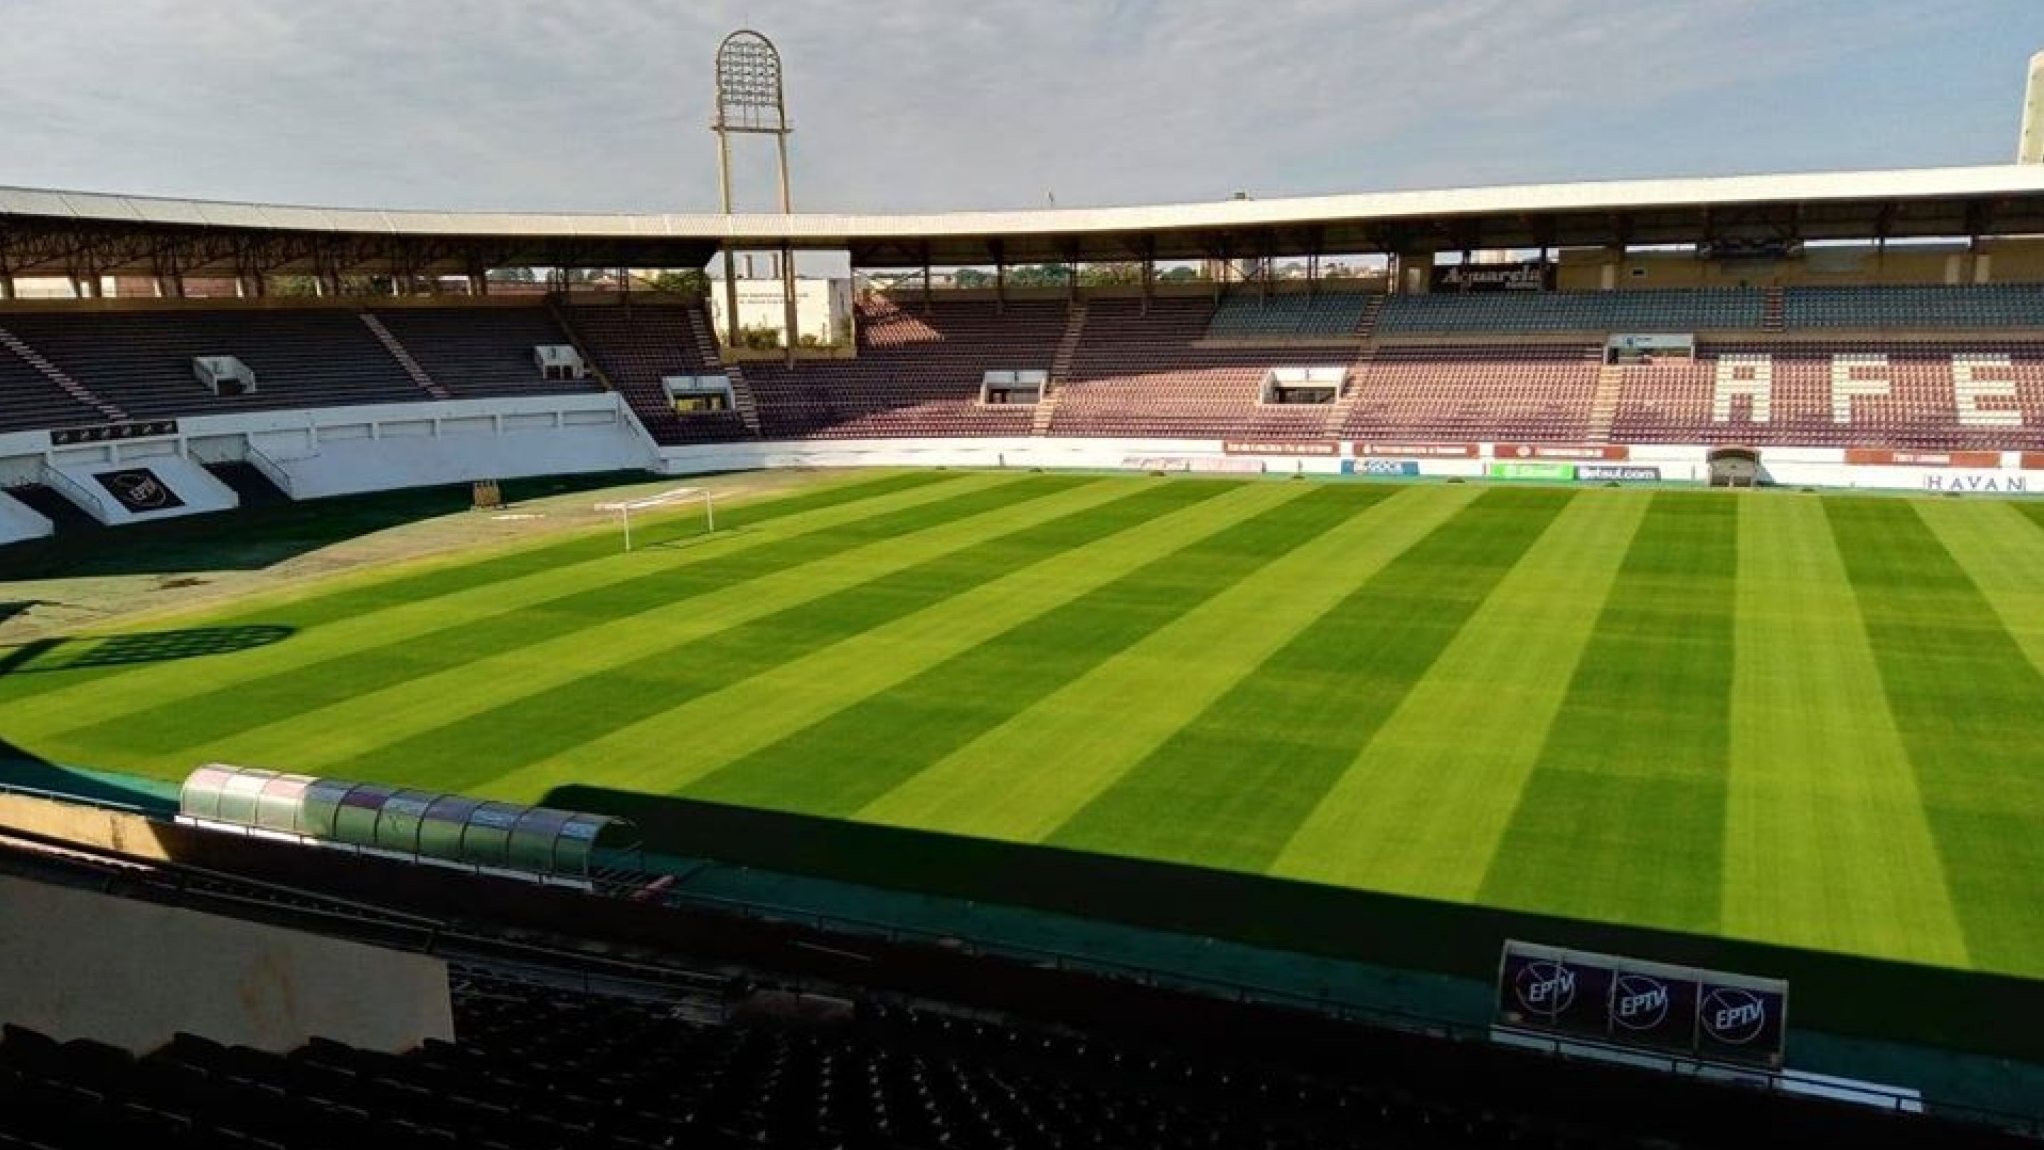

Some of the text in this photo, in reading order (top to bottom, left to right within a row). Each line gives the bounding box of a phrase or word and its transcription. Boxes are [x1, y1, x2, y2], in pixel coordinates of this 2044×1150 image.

[1927, 475, 2024, 490] HAVAN
[1620, 986, 1667, 1016] EPTV
[1715, 1000, 1763, 1030] EPTV
